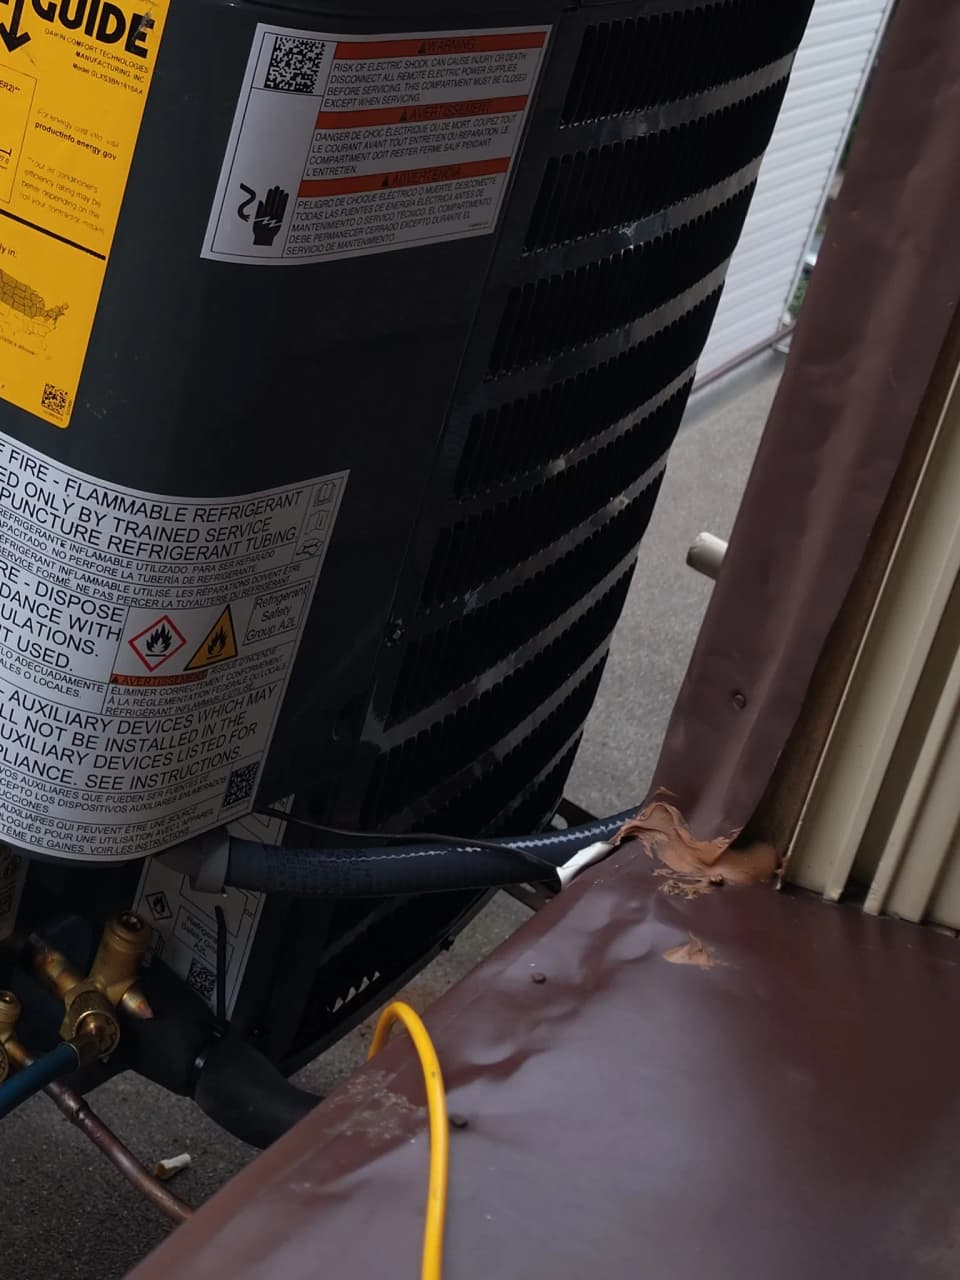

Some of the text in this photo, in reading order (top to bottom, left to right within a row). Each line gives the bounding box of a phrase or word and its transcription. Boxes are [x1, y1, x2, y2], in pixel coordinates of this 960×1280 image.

[66, 36, 97, 52] COMFORT
[333, 63, 355, 72] RISK
[315, 131, 350, 142] DANGER
[9, 449, 49, 482] FIRE
[64, 478, 188, 522] FLAMMABLE
[192, 490, 303, 523] REFRIGERANT
[0, 487, 103, 546] PUNCTURE
[107, 535, 242, 561] REFRIGERANT
[24, 482, 75, 515] ONLY
[79, 506, 107, 527] BY
[113, 517, 199, 543] TRAINED
[204, 517, 272, 542] SERVICE
[35, 580, 125, 623] DISPOSE
[69, 614, 122, 642] WITH
[17, 636, 73, 671] USED.
[8, 690, 114, 735] AUXILIARY
[117, 714, 193, 735] DEVICES
[198, 698, 244, 722] WHICH
[246, 684, 278, 708] MAY
[25, 716, 67, 742] NOT
[72, 732, 100, 750] BE
[105, 727, 199, 753] INSTALLED
[202, 721, 216, 737] IN
[220, 711, 247, 728] THE
[93, 750, 174, 770] DEVICES
[177, 733, 227, 763] LISTED
[228, 721, 258, 744] FOR
[85, 775, 126, 790] SEE
